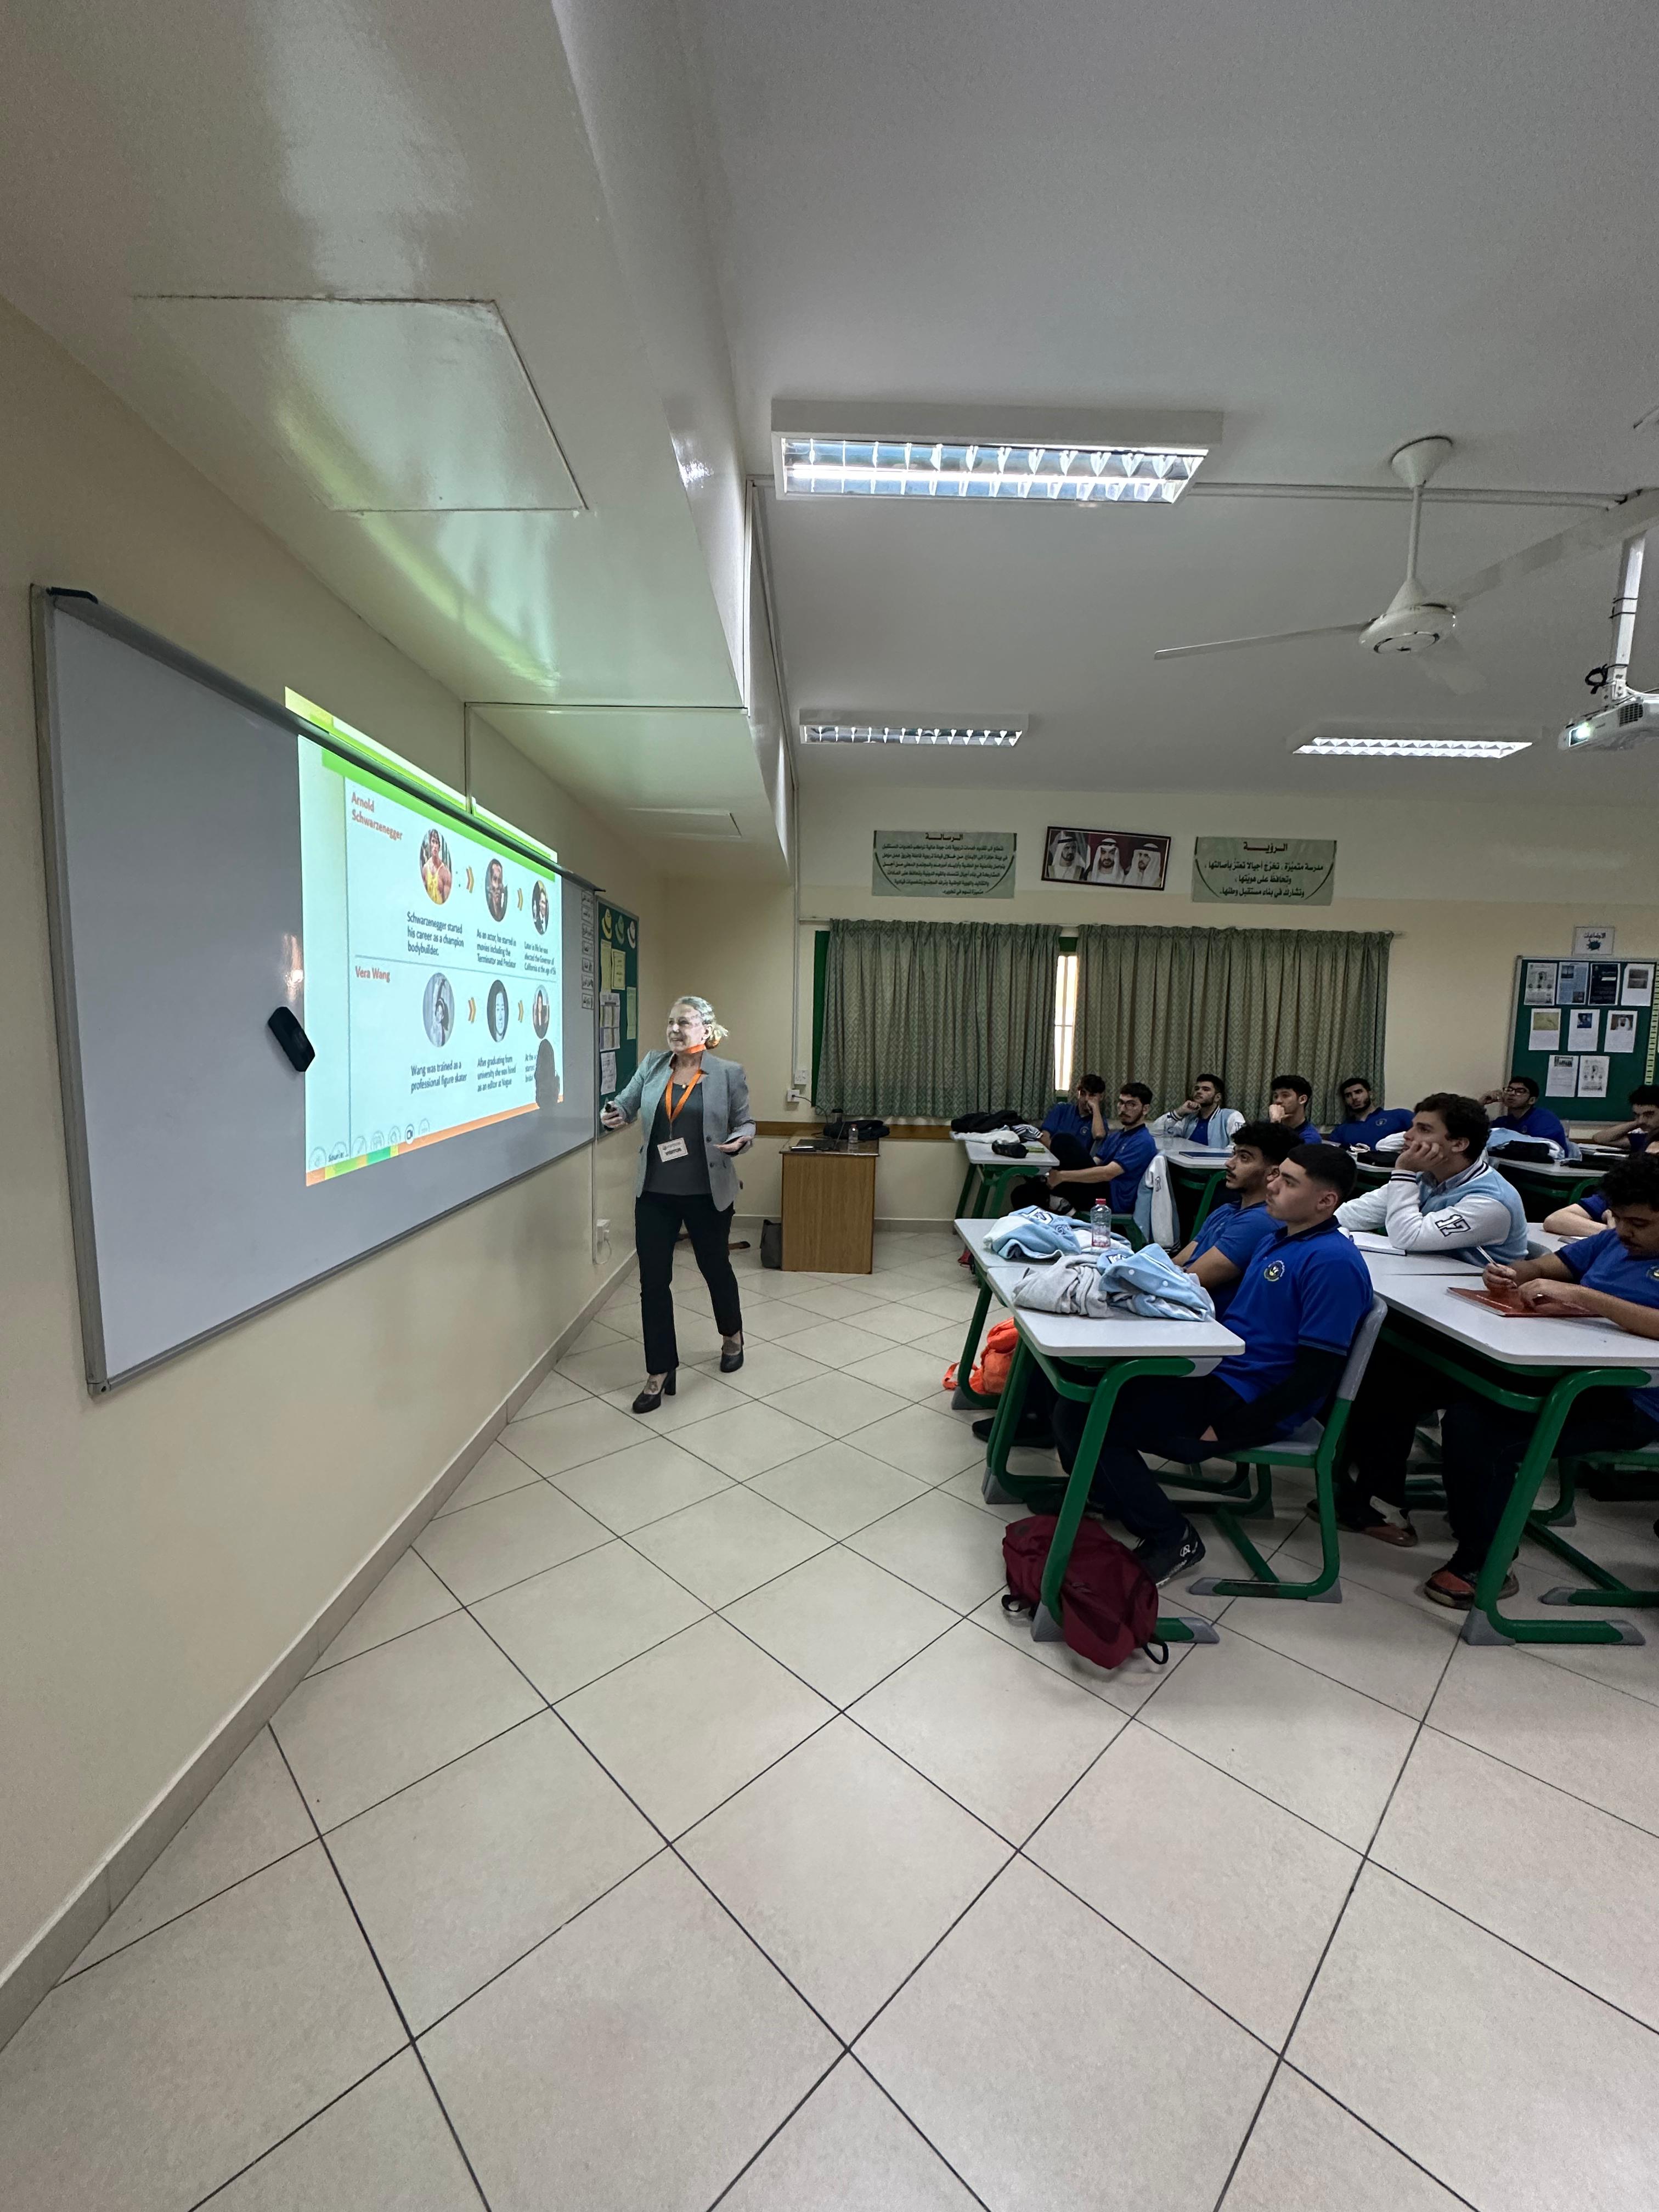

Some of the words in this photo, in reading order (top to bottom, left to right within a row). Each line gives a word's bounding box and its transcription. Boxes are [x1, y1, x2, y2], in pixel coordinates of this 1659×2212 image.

[351, 792, 374, 812] Arnold
[352, 809, 403, 840] Schwarzenegger
[926, 833, 963, 842] الرسالة
[1243, 842, 1288, 854] الرؤية
[1305, 862, 1323, 872] مدرسة
[1257, 875, 1268, 884] على
[1239, 887, 1261, 897] مستقبل
[1262, 888, 1273, 897] بناء
[1274, 888, 1282, 898] في
[407, 911, 447, 932] Schwarzenegger
[448, 923, 462, 934] started
[416, 931, 432, 941] career
[443, 934, 464, 948] champion
[356, 966, 371, 979] Vera
[372, 967, 390, 983] Wang
[411, 1065, 426, 1077] Wang
[437, 1059, 453, 1072] trained
[459, 1061, 461, 1069] a
[411, 1076, 441, 1094] professional
[441, 1075, 454, 1088] figure
[455, 1073, 467, 1083] skater
[1435, 1214, 1472, 1237] 17
